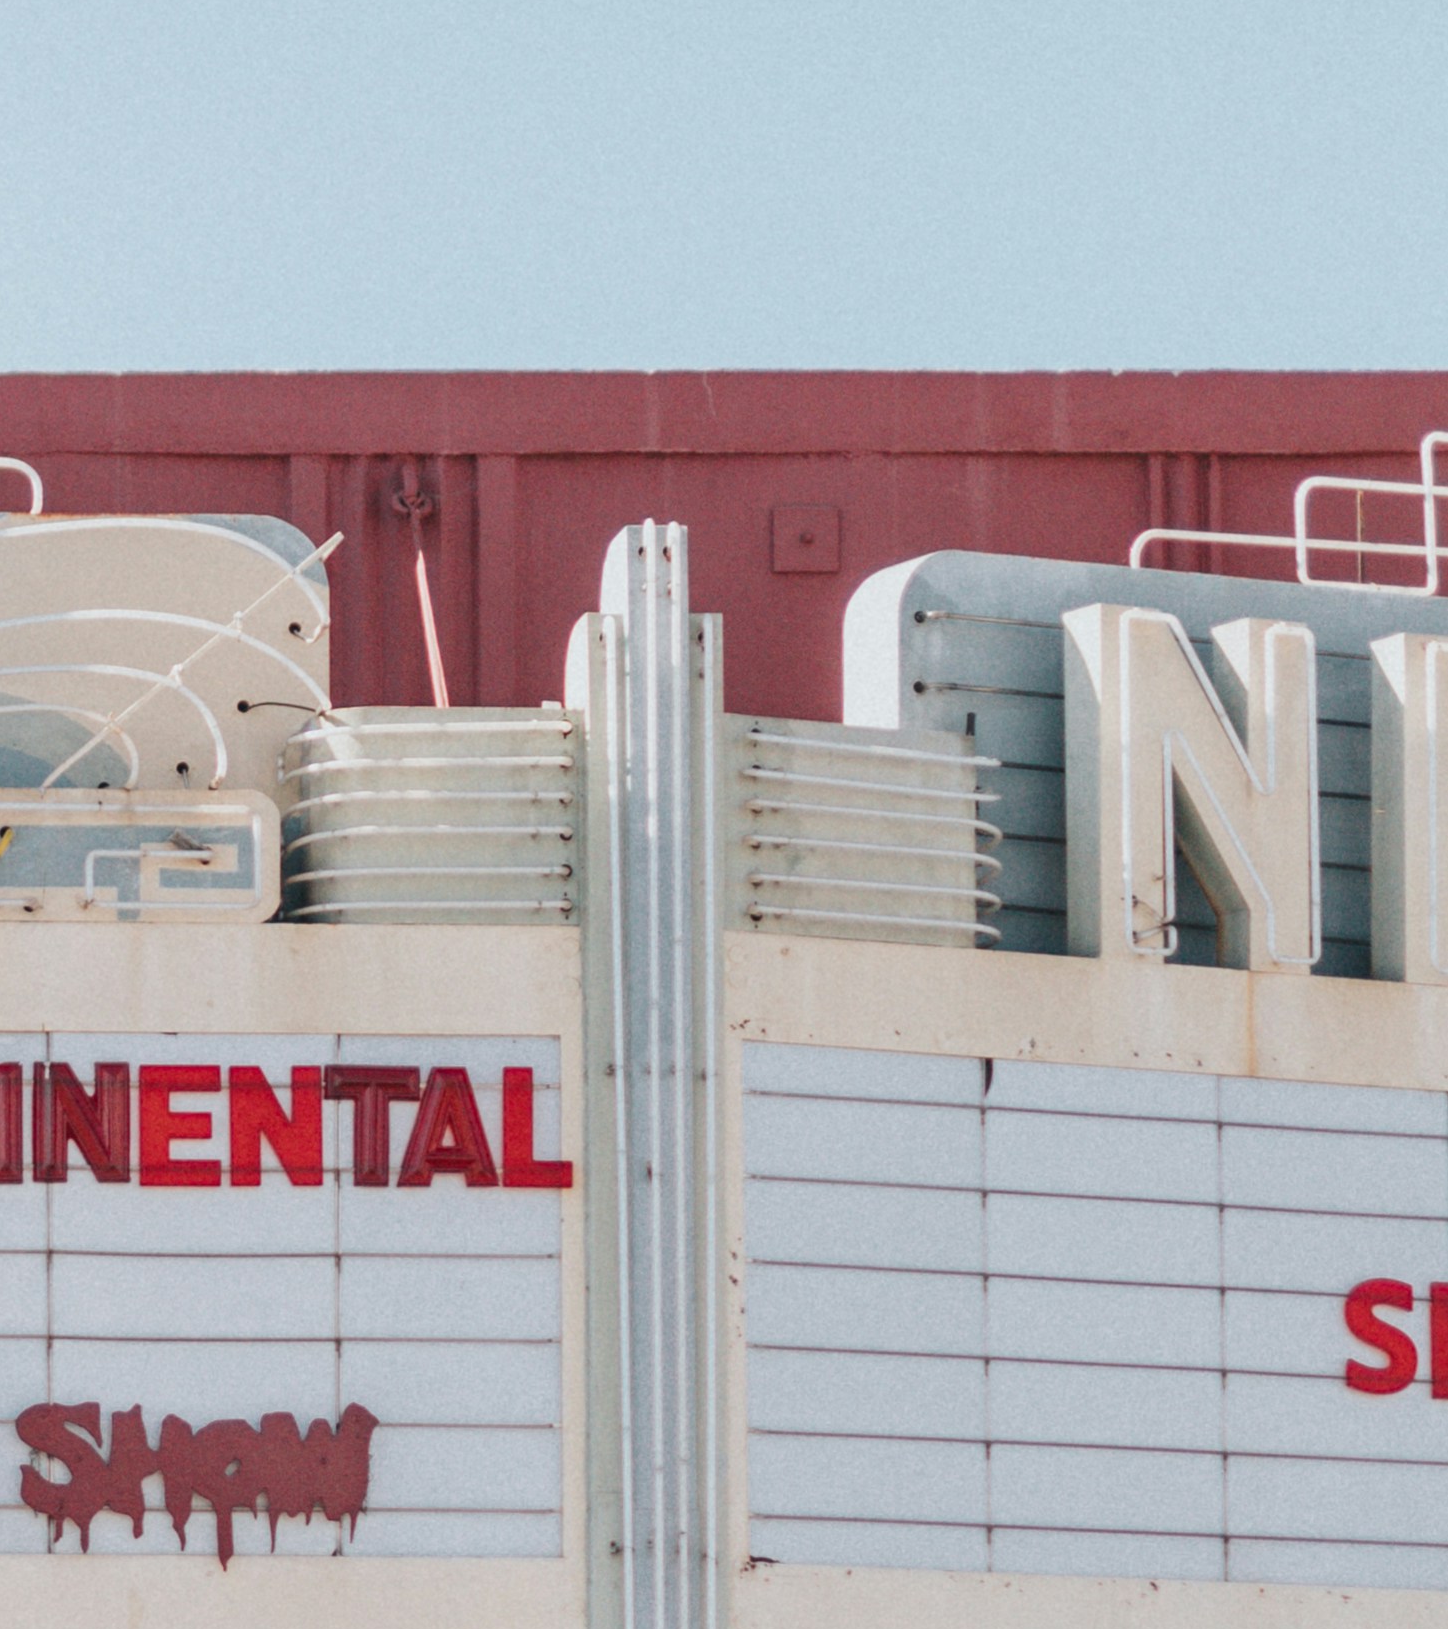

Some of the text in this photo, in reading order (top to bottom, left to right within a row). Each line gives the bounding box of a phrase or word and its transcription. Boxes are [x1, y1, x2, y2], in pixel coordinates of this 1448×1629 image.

[1062, 602, 1448, 984] N
[1343, 1277, 1448, 1399] S
[15, 1402, 379, 1571] SHOW
